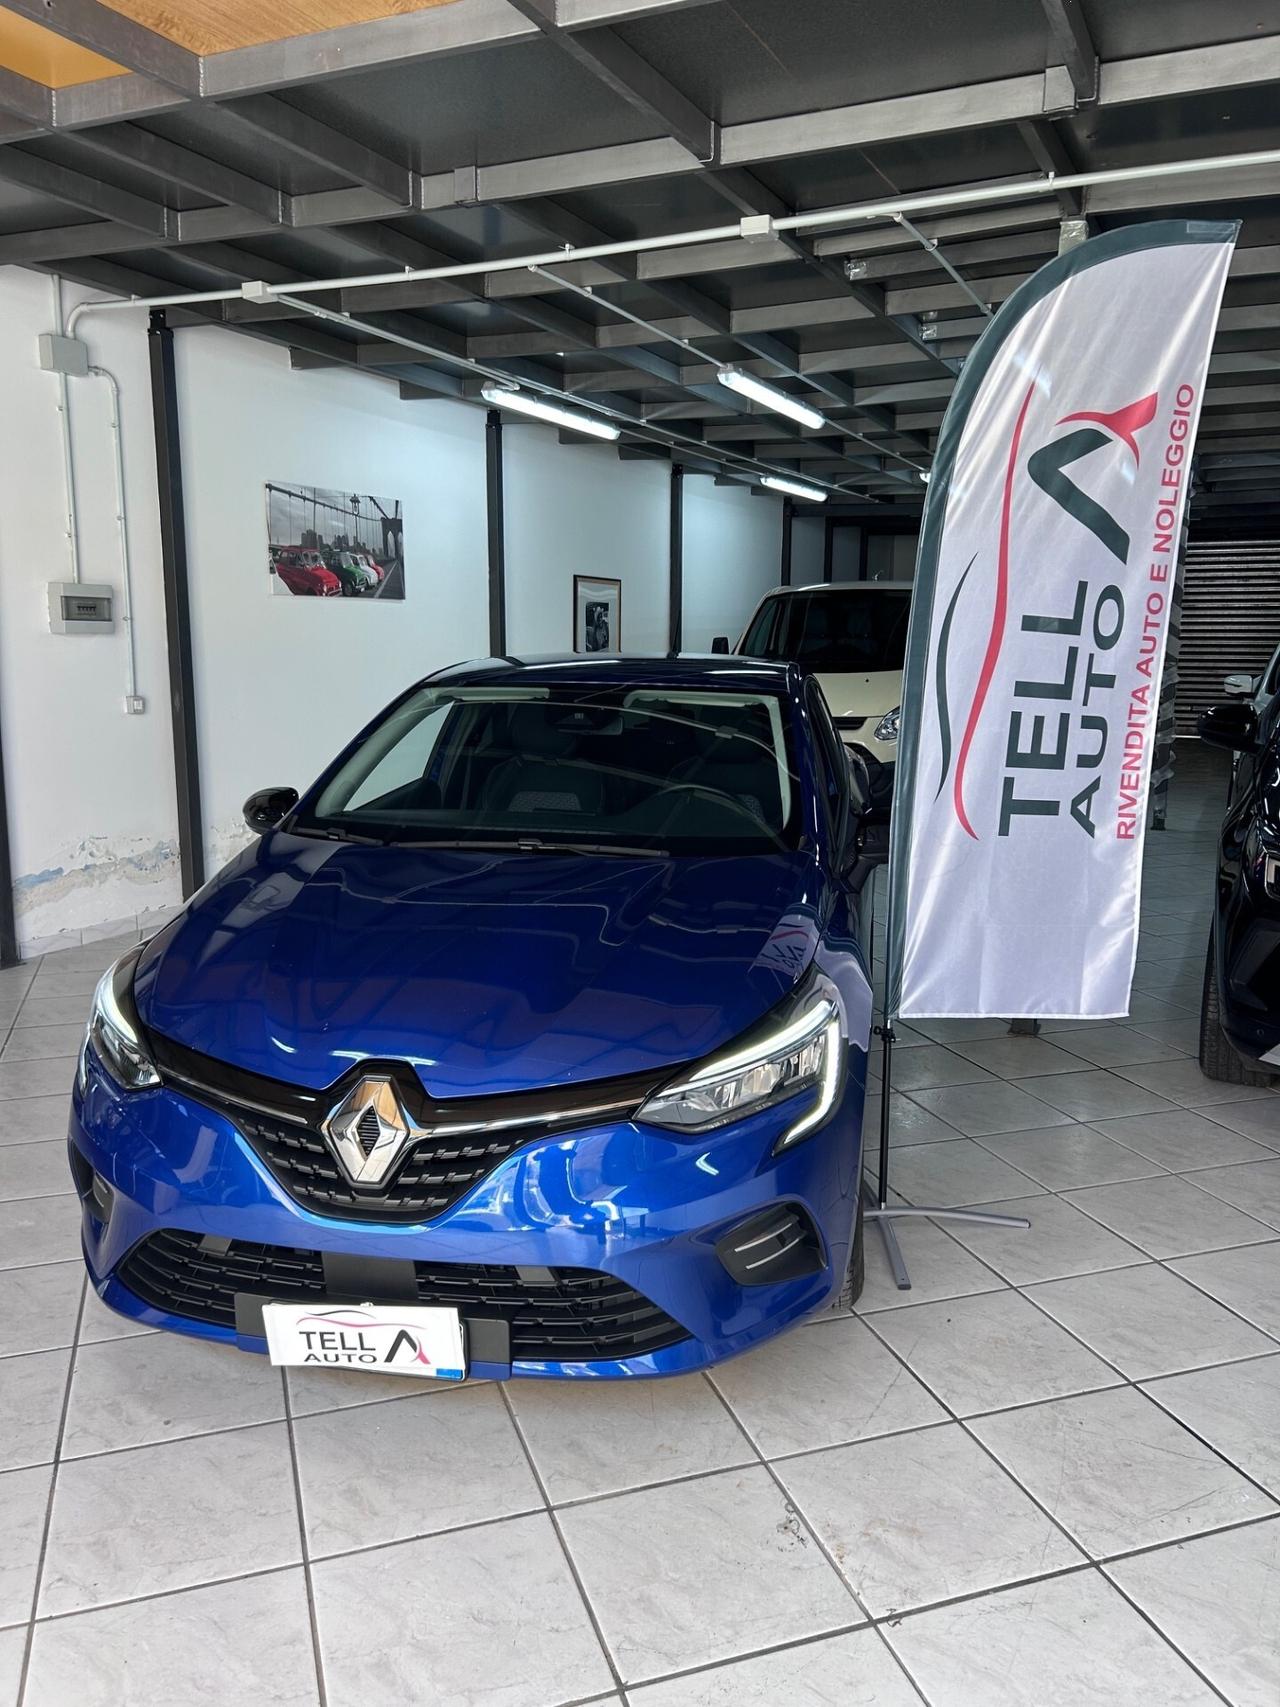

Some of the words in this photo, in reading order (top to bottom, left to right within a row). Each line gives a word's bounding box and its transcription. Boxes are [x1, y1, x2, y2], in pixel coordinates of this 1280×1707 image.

[1153, 383, 1195, 554] NOLEGGIO
[1150, 563, 1169, 583] E
[1138, 592, 1165, 677] AUTO
[1069, 584, 1125, 839] AUTO
[1116, 683, 1151, 840] RIVENDITA
[303, 1353, 377, 1363] AUTO
